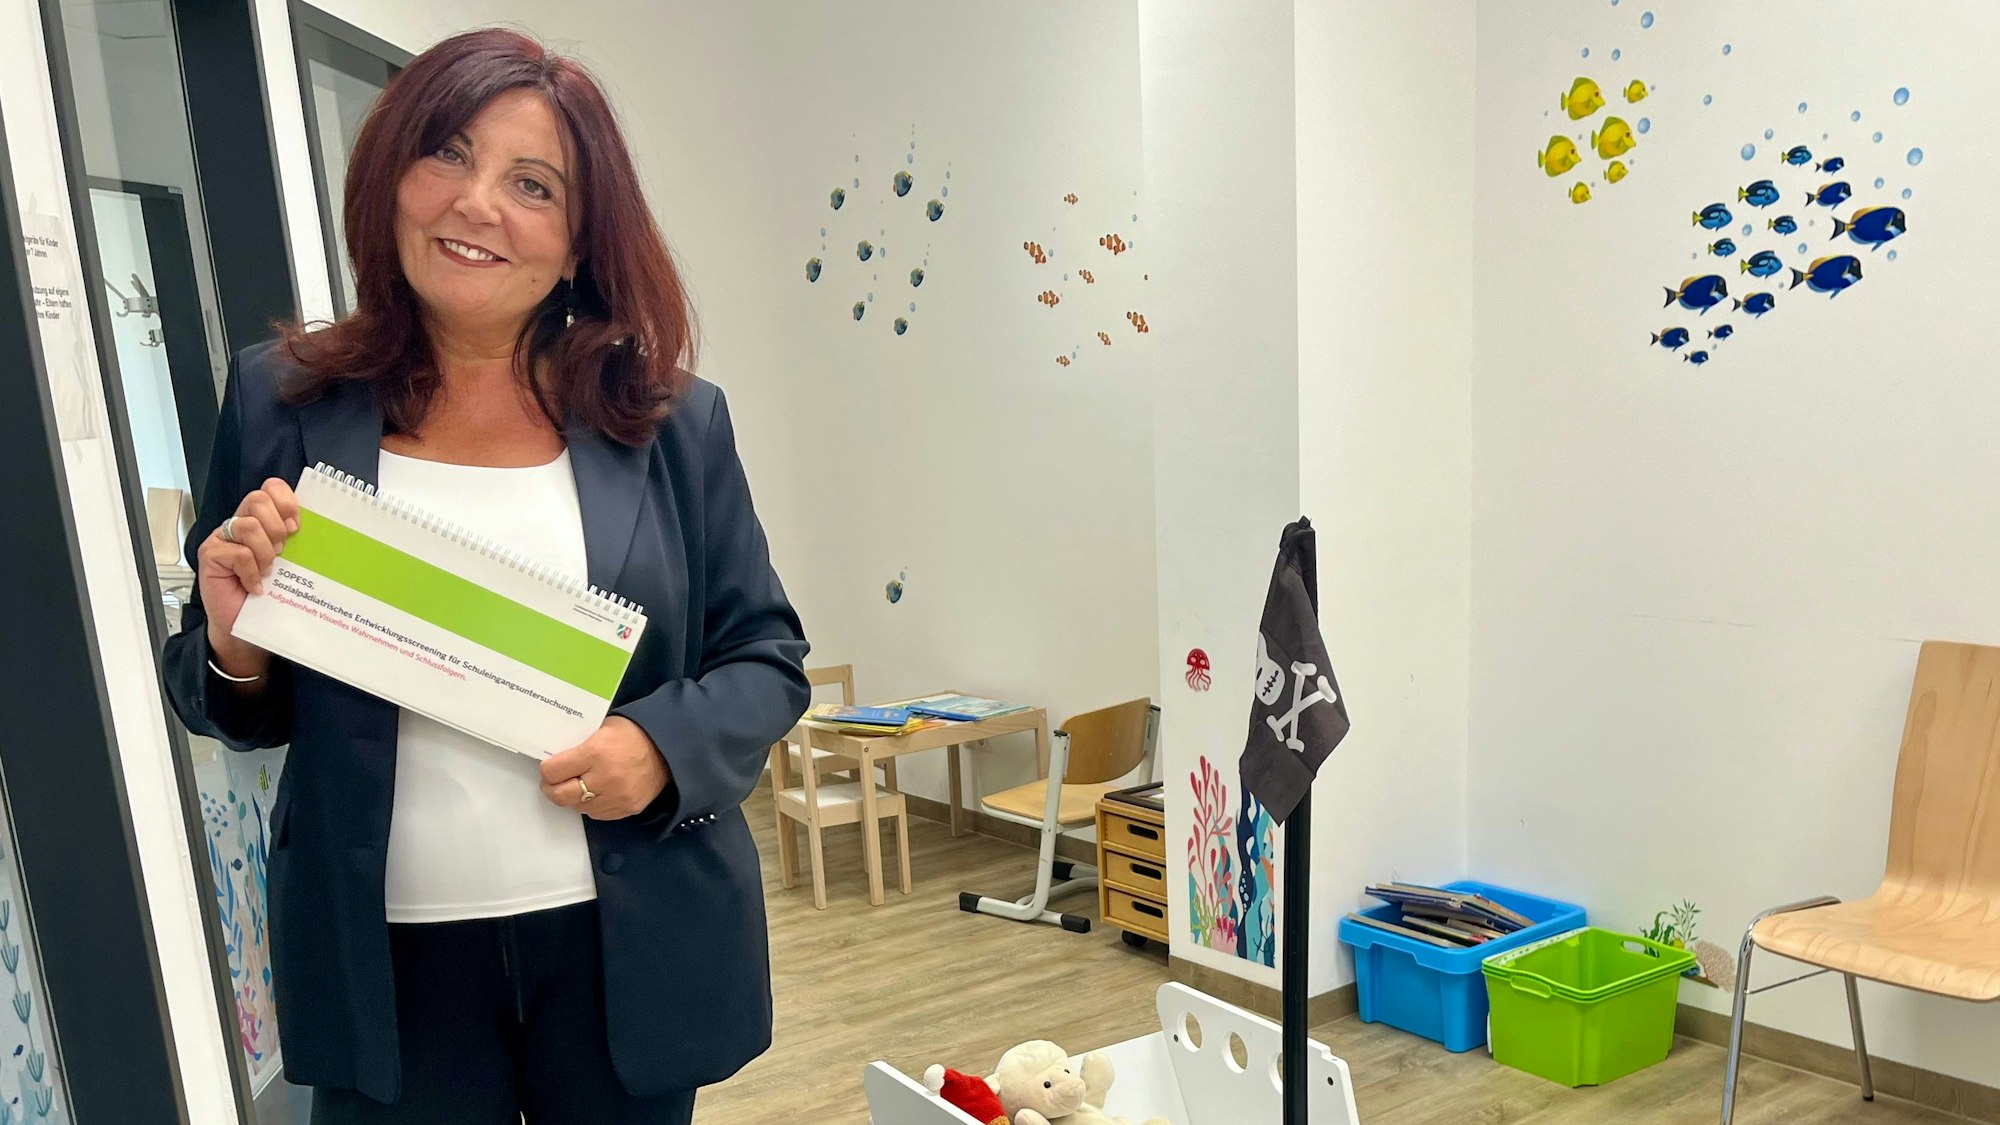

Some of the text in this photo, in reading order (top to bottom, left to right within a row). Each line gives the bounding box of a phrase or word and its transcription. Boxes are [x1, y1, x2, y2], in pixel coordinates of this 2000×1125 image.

[45, 310, 60, 319] Kinder
[277, 567, 316, 590] SOPESS.
[266, 590, 467, 682] Aufgabenheft Visuelles Wahrnehmen und Schlussfolgern.
[272, 578, 585, 719] Sozialpädiatrisches Entwicklungsscreening für Schuleingangsuntersuchungen.
